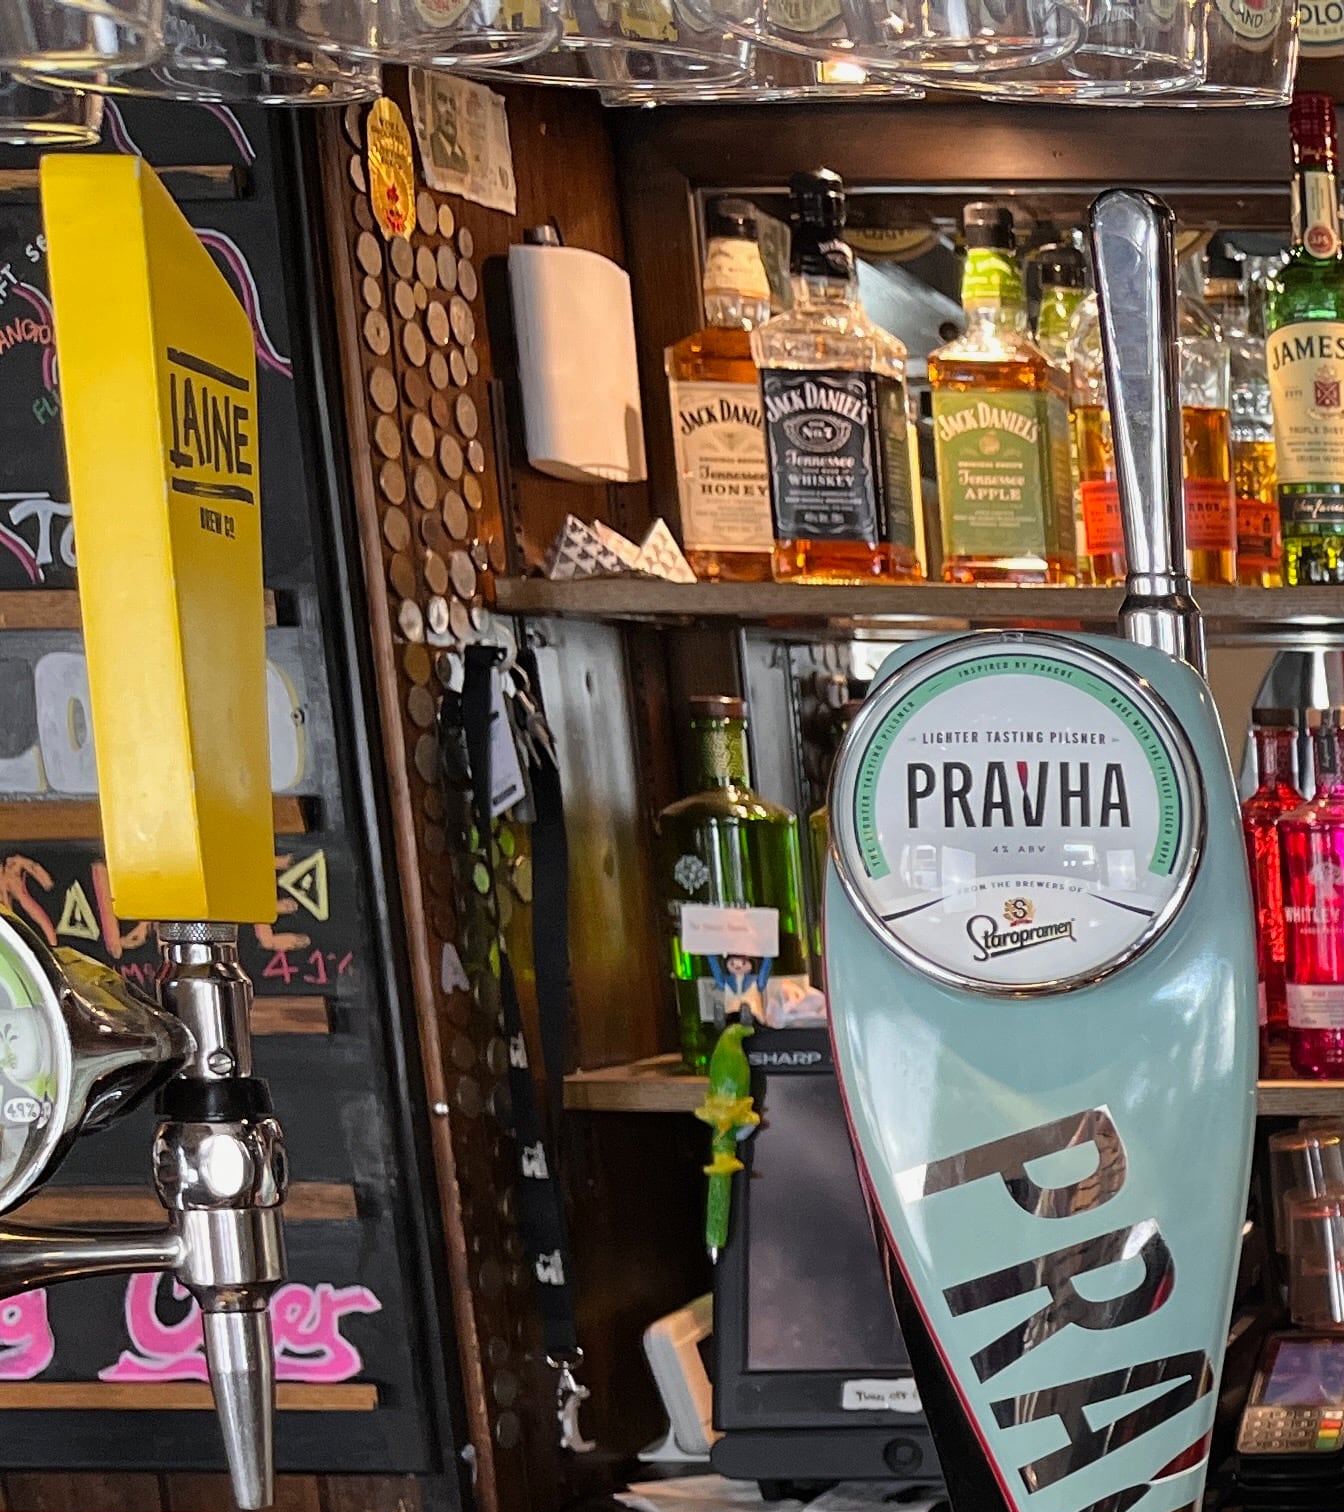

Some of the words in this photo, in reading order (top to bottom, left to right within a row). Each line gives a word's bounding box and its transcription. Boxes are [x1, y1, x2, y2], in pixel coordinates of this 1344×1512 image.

[680, 404, 717, 436] JACK
[765, 388, 806, 424] JACK
[170, 373, 252, 476] LAINE
[938, 409, 978, 443] JACK
[701, 483, 768, 497] HONEY
[788, 474, 855, 488] WHISKEY
[964, 487, 1021, 501] APPLE
[922, 731, 979, 746] LIGHTER
[985, 730, 1044, 744] TASTING
[1049, 731, 1106, 746] PILSNER
[906, 760, 1132, 829] PRAVHA
[966, 914, 1077, 962] Staropramen
[749, 1051, 822, 1065] SHARP
